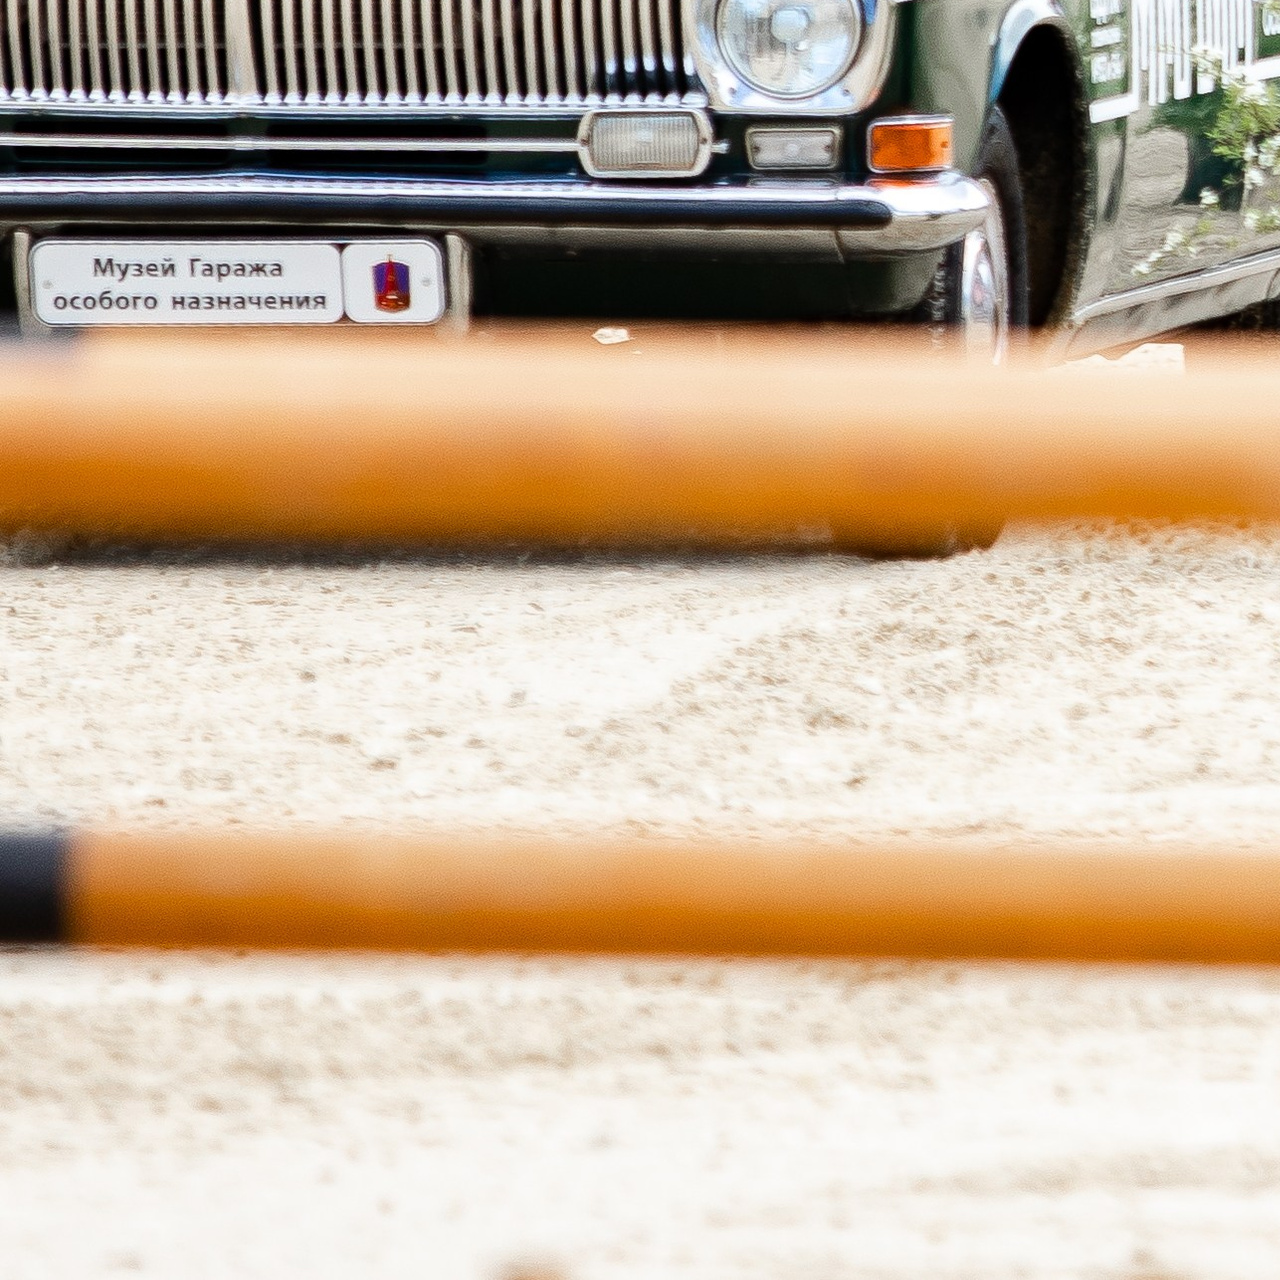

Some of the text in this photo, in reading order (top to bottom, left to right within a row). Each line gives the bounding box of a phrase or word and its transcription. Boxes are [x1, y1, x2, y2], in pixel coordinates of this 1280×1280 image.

[93, 256, 283, 283] Музей Гаража
[53, 289, 327, 311] особого назначения
